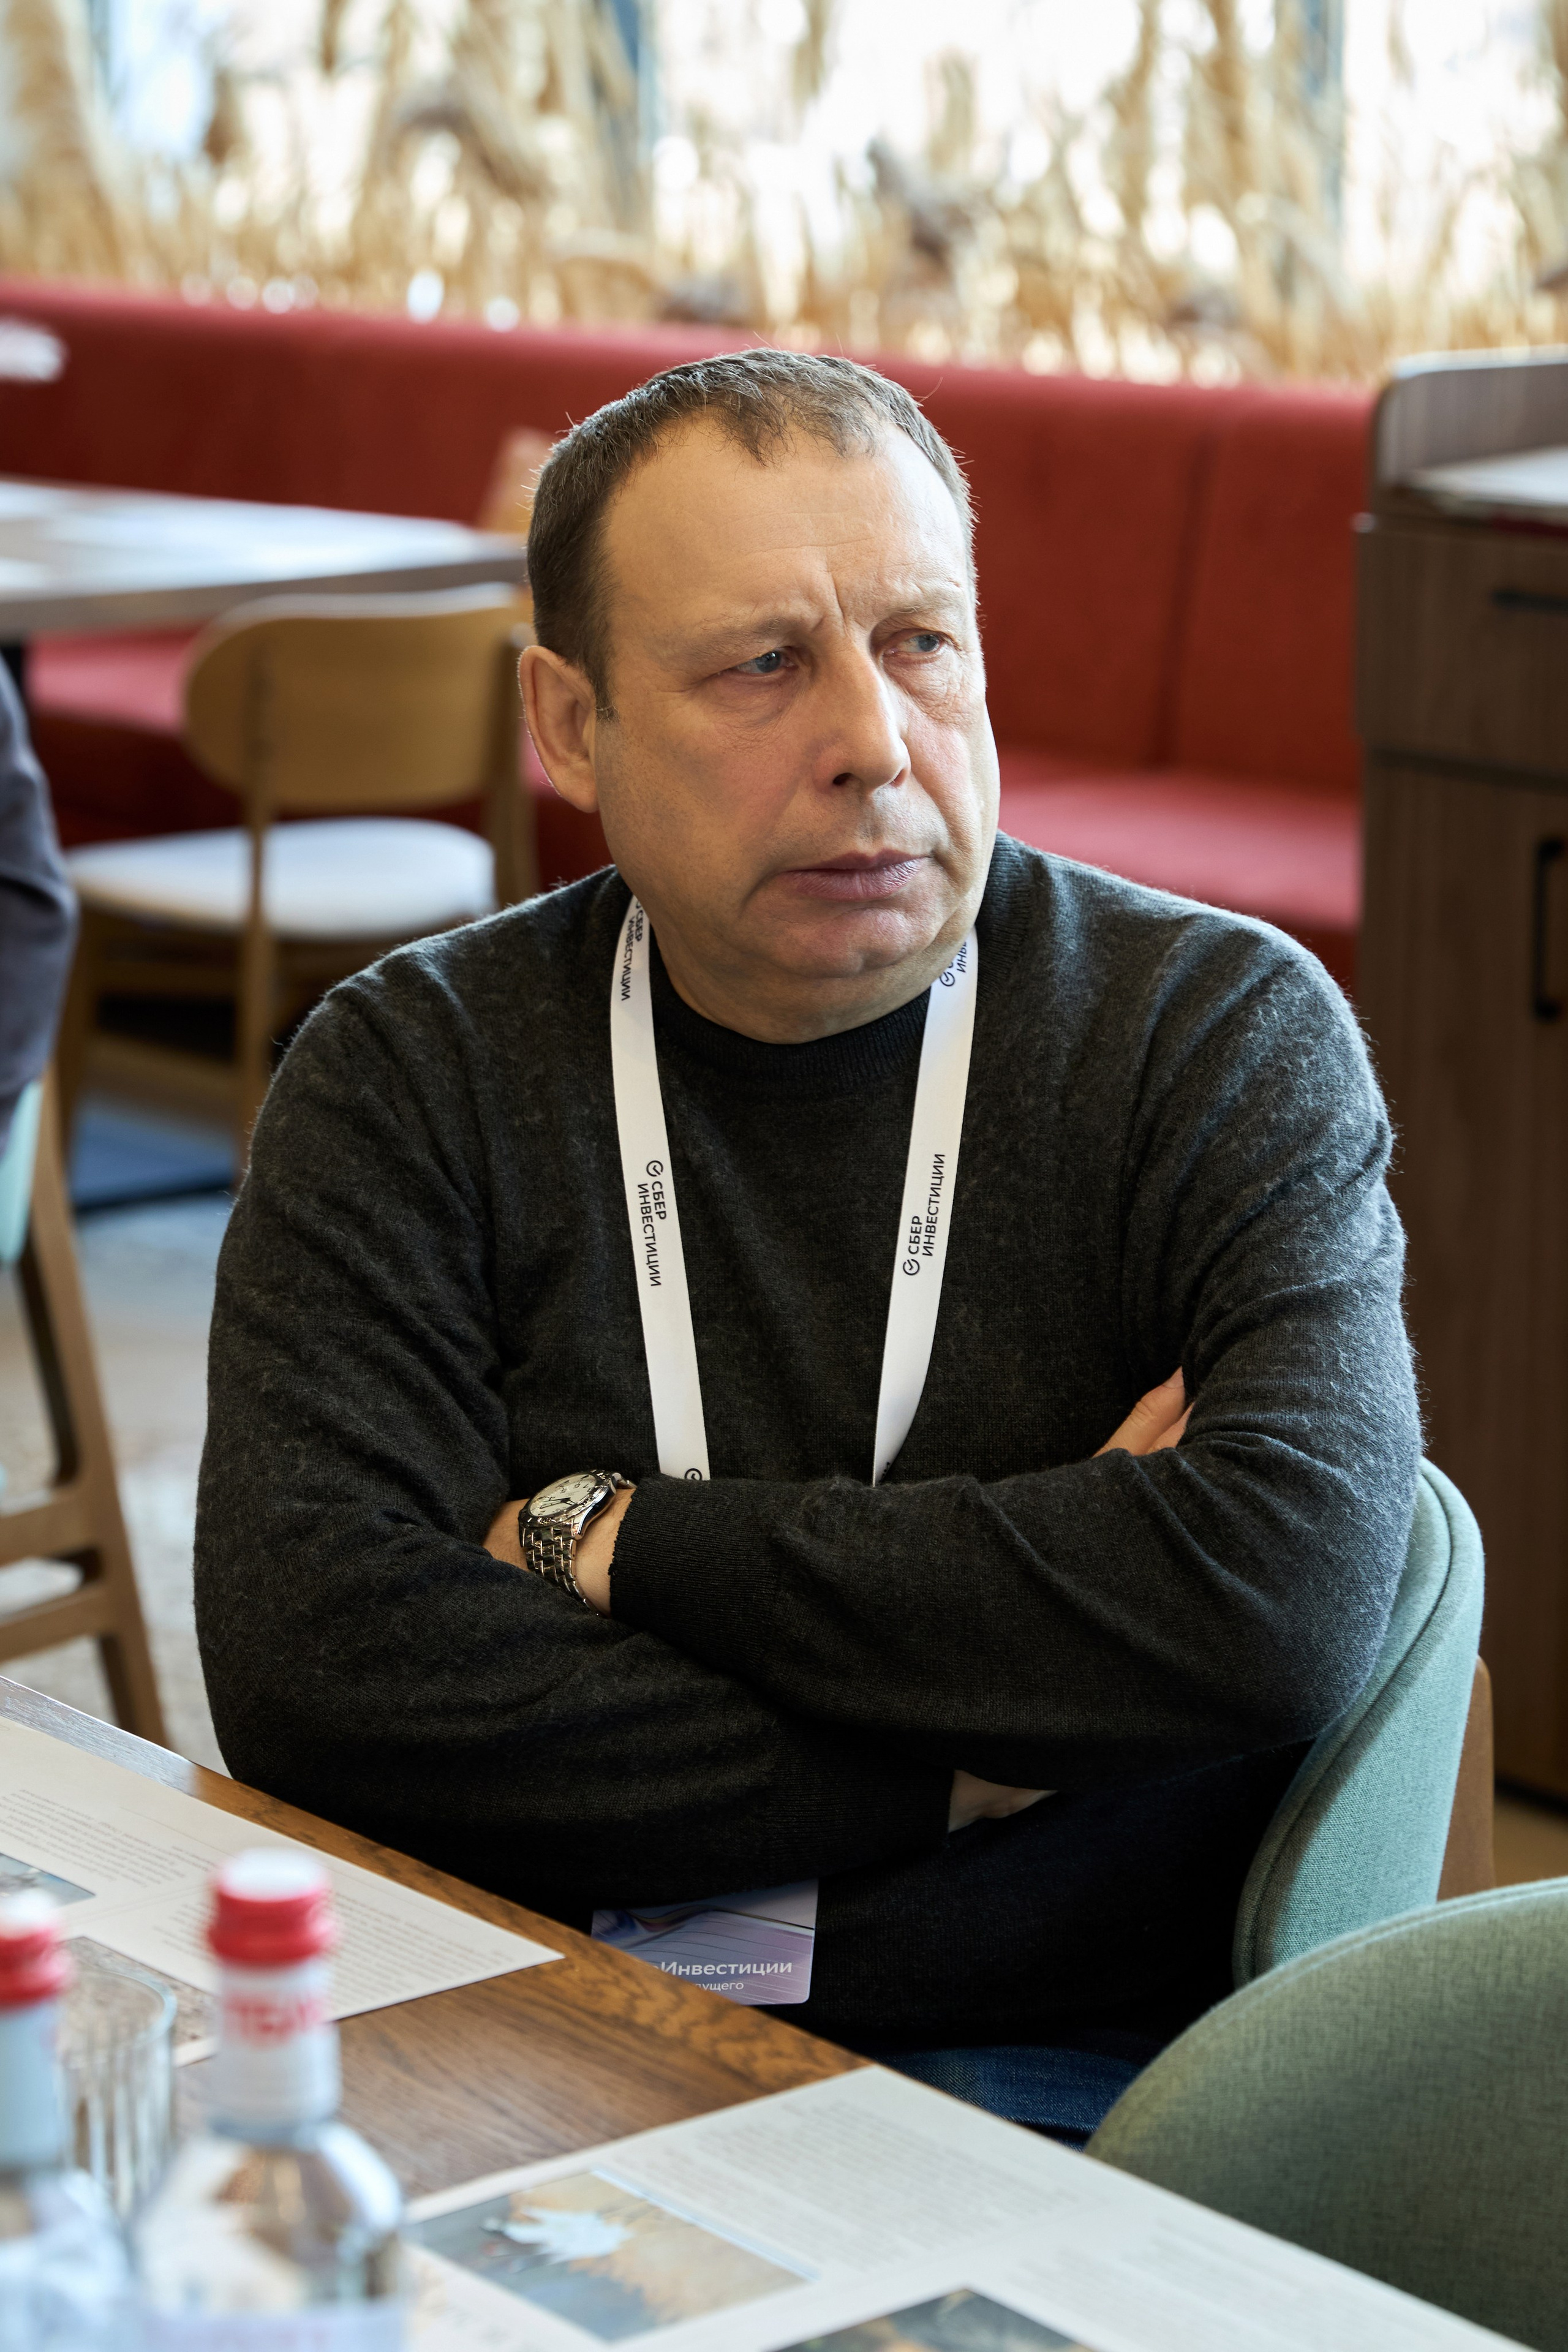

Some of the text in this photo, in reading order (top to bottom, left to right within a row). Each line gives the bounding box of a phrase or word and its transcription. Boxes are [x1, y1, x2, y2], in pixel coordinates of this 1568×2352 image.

[620, 916, 635, 1001] ИНВЕСТИЦИИ
[652, 1181, 666, 1219] СБЕР
[922, 1154, 945, 1256] ИНВЕСТИЦИИ
[638, 1183, 662, 1286] ИНВЕСТИЦИИ
[908, 1216, 922, 1254] СБЕР
[653, 1961, 793, 1976] Инвестиции
